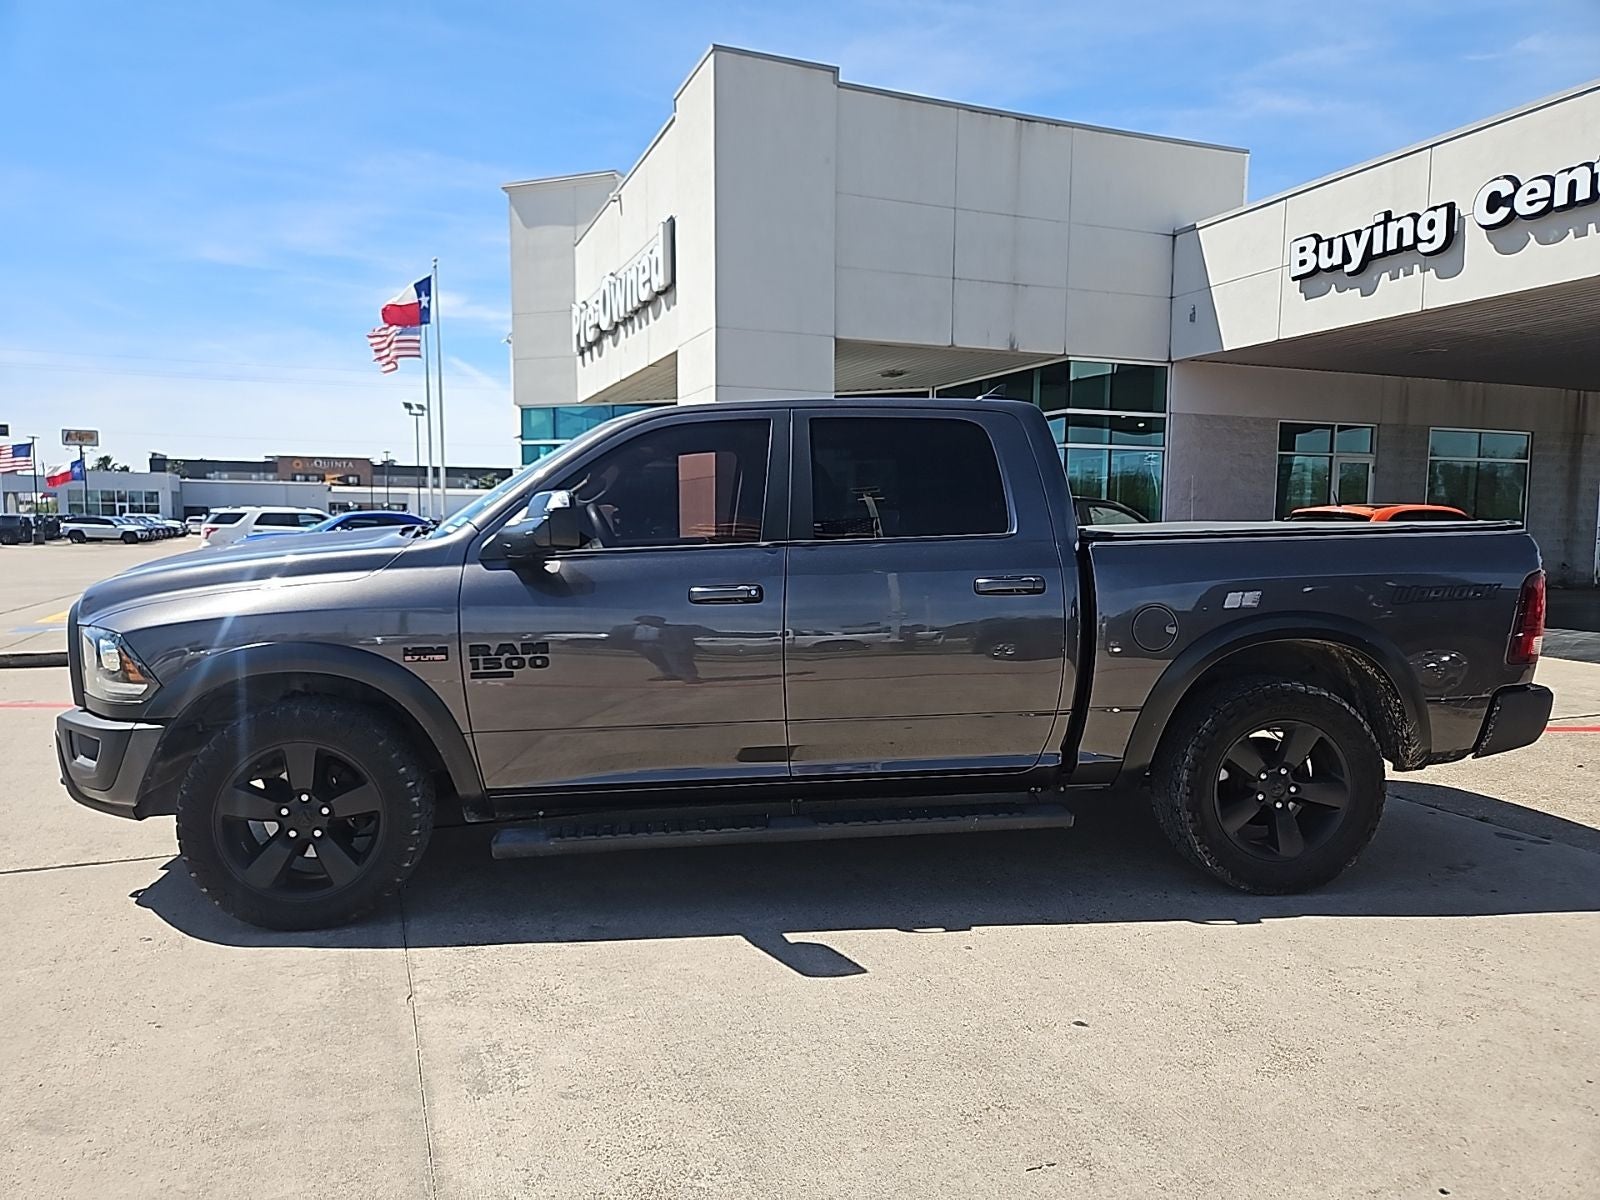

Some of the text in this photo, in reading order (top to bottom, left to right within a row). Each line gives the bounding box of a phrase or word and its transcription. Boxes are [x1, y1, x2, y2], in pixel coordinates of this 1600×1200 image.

[1290, 202, 1457, 281] Buying
[571, 217, 676, 352] Pre-Owned
[468, 642, 549, 657] RAM
[469, 656, 550, 671] 1500
